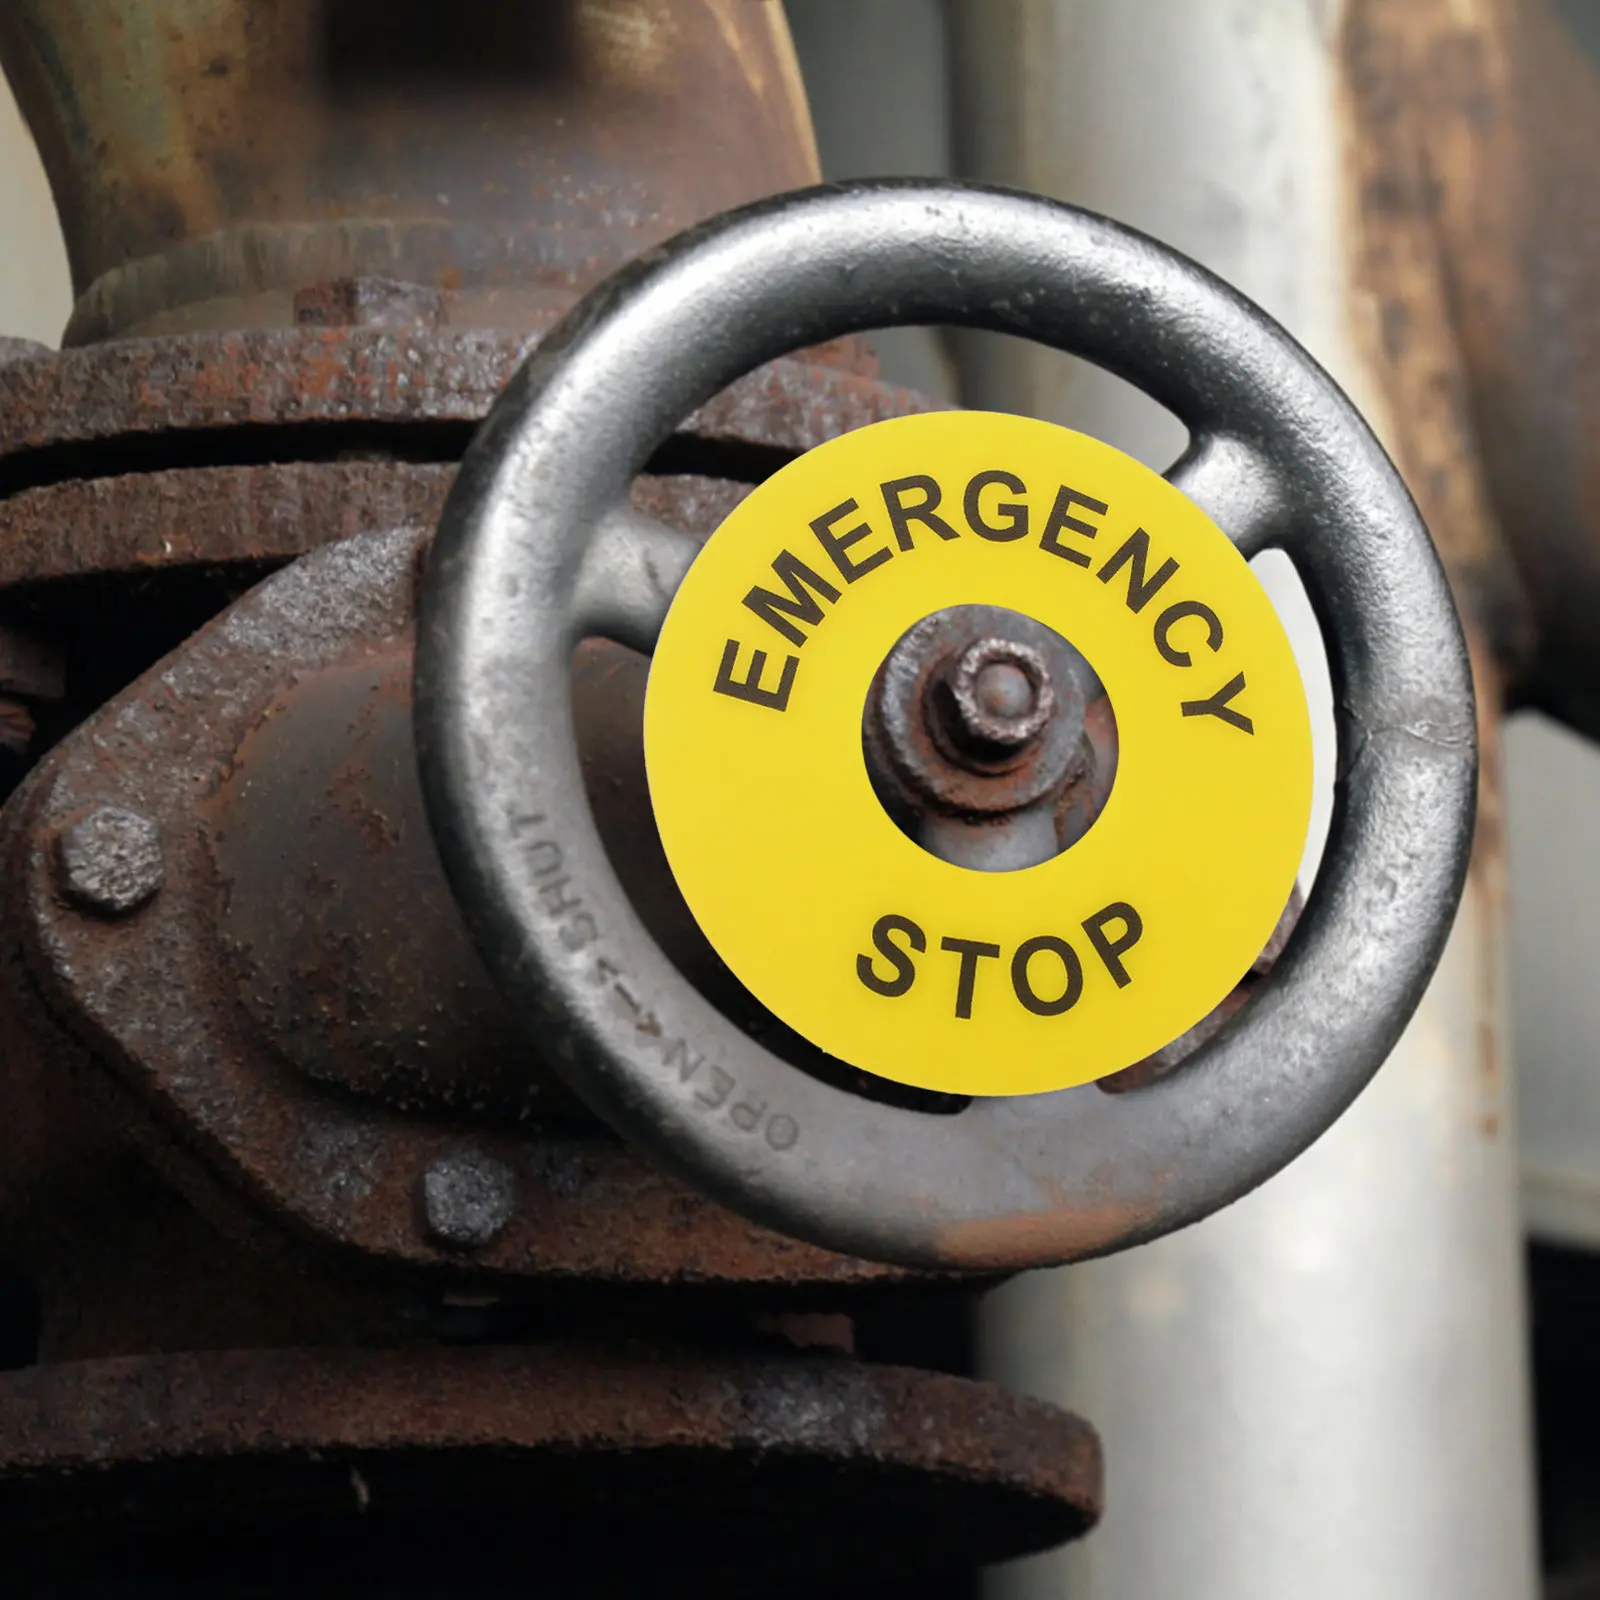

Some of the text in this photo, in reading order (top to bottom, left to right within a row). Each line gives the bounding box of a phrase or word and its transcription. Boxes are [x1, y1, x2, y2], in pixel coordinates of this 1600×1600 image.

[712, 470, 1255, 736] EMERGENCY
[506, 804, 799, 1151] OPEN SHUT
[855, 901, 1144, 1020] STOP
